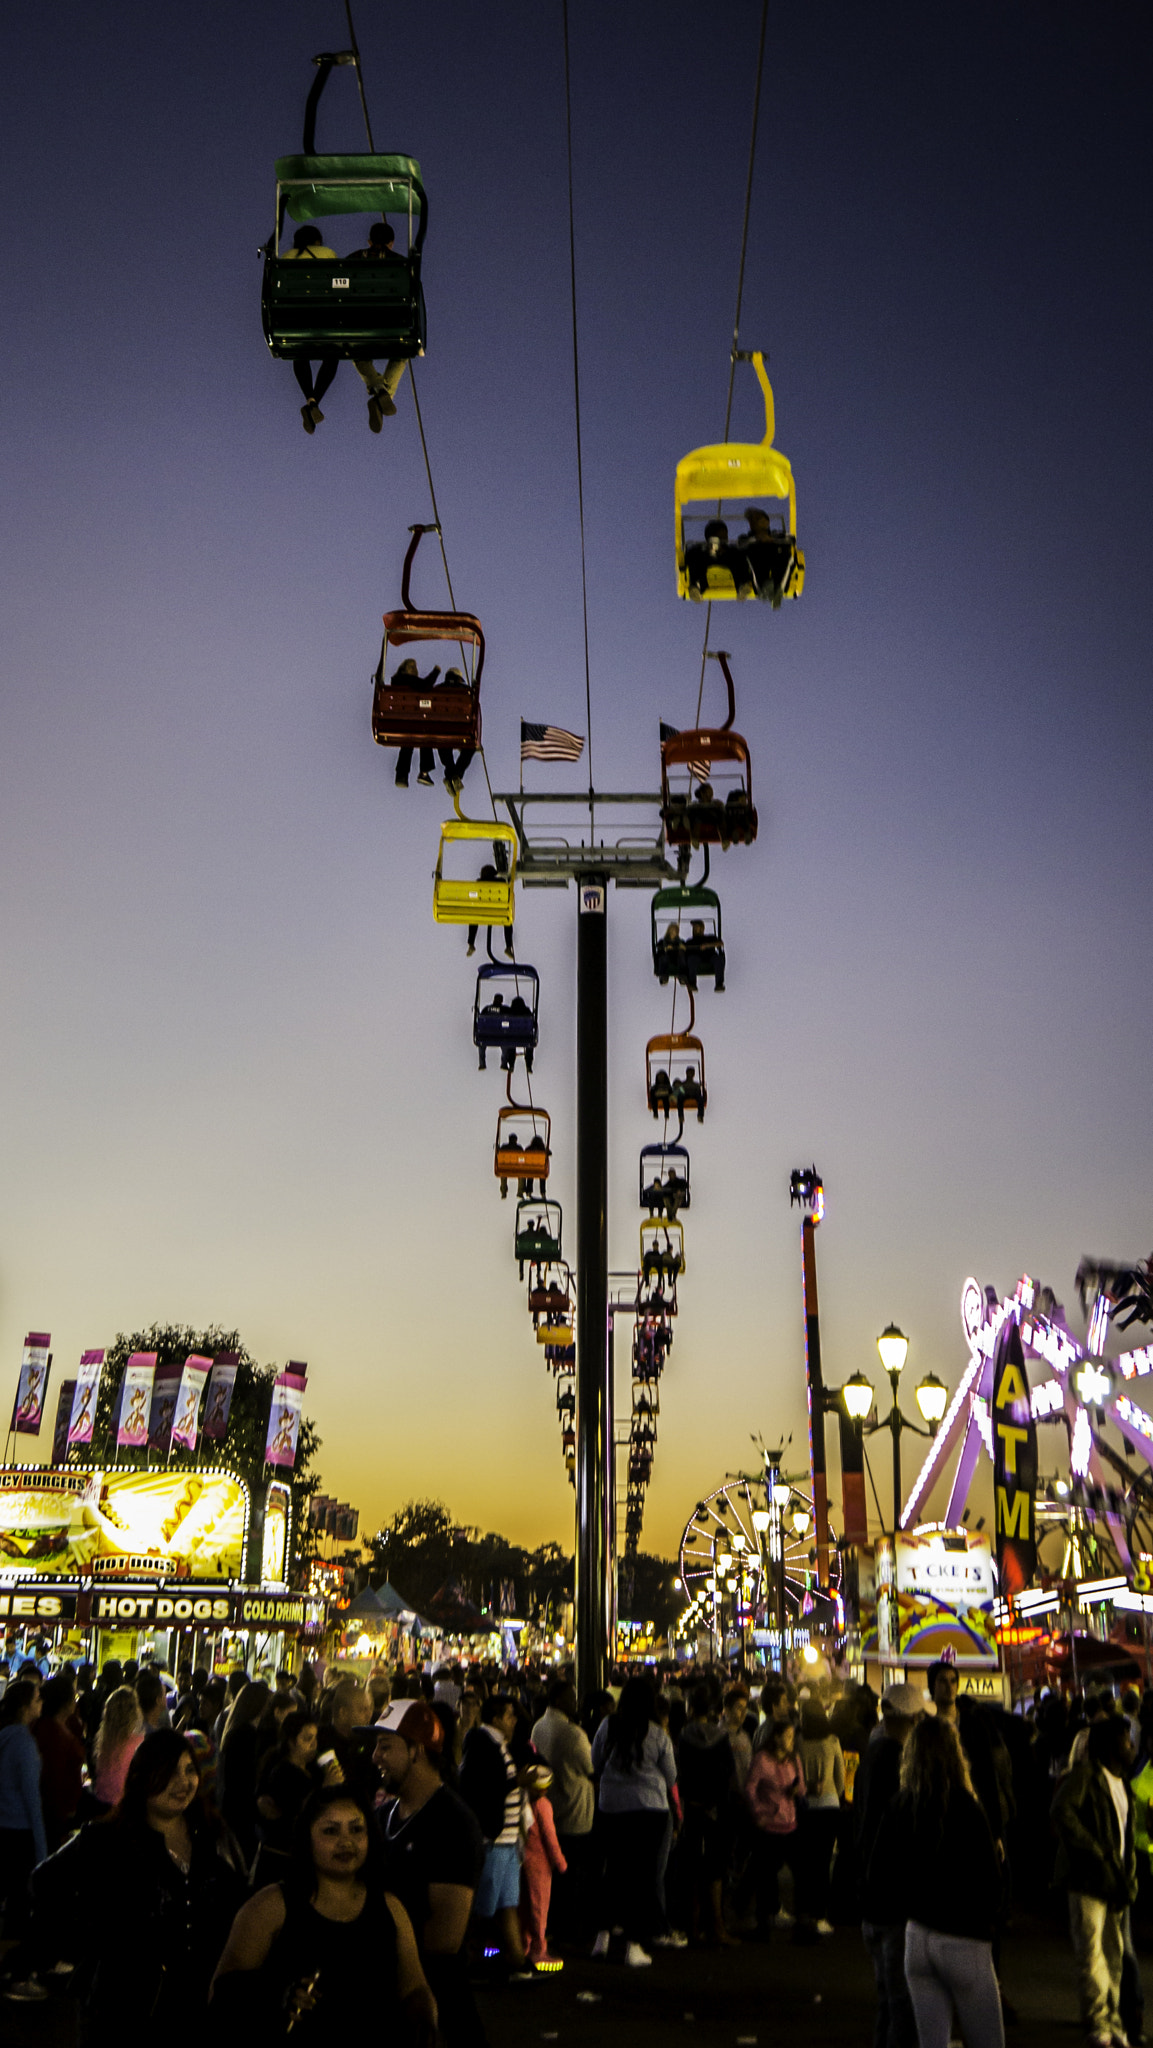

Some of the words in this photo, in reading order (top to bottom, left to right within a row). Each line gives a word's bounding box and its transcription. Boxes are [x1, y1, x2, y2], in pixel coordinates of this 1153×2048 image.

[995, 1363, 1030, 1540] ATM
[0, 1474, 21, 1488] CY
[22, 1474, 86, 1490] BURGERS
[94, 1555, 128, 1573] HOT
[129, 1555, 176, 1574] DOGS
[908, 1563, 982, 1582] TCKETS
[98, 1597, 154, 1618] HOT
[156, 1598, 230, 1619] DOGS
[243, 1599, 275, 1621] COLD
[965, 1678, 994, 1693] ATM
